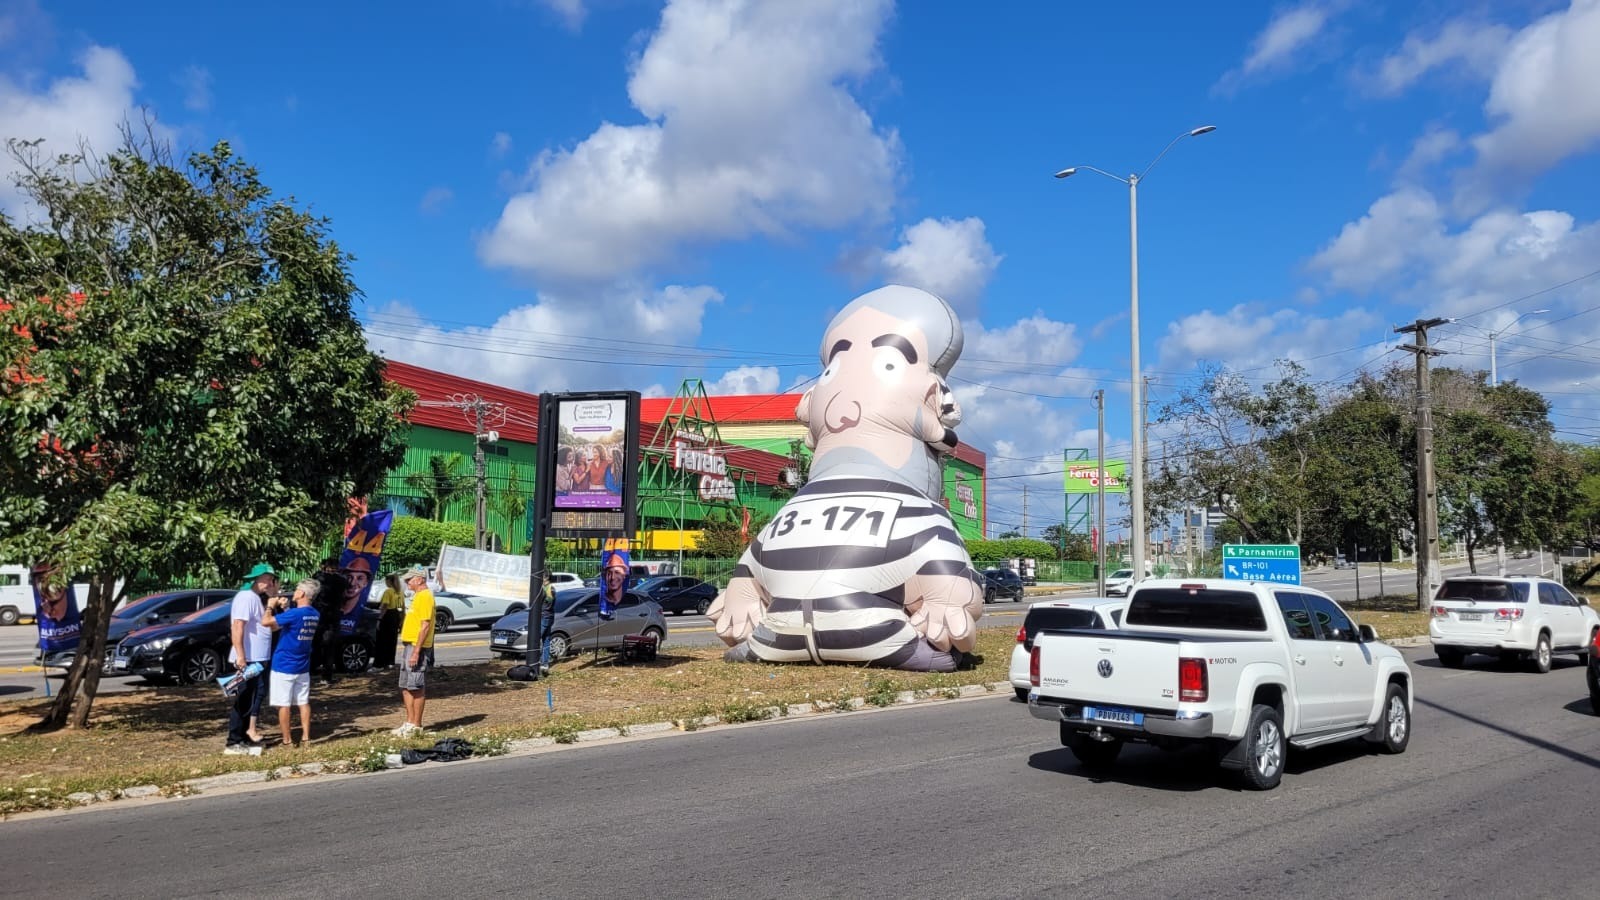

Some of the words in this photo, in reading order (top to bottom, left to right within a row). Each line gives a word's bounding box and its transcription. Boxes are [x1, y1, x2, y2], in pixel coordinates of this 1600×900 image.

[675, 441, 726, 475] Ferreira
[700, 475, 736, 499] Costa
[347, 529, 385, 556] 44
[1238, 548, 1295, 556] Parnamirim
[1242, 572, 1264, 580] Base
